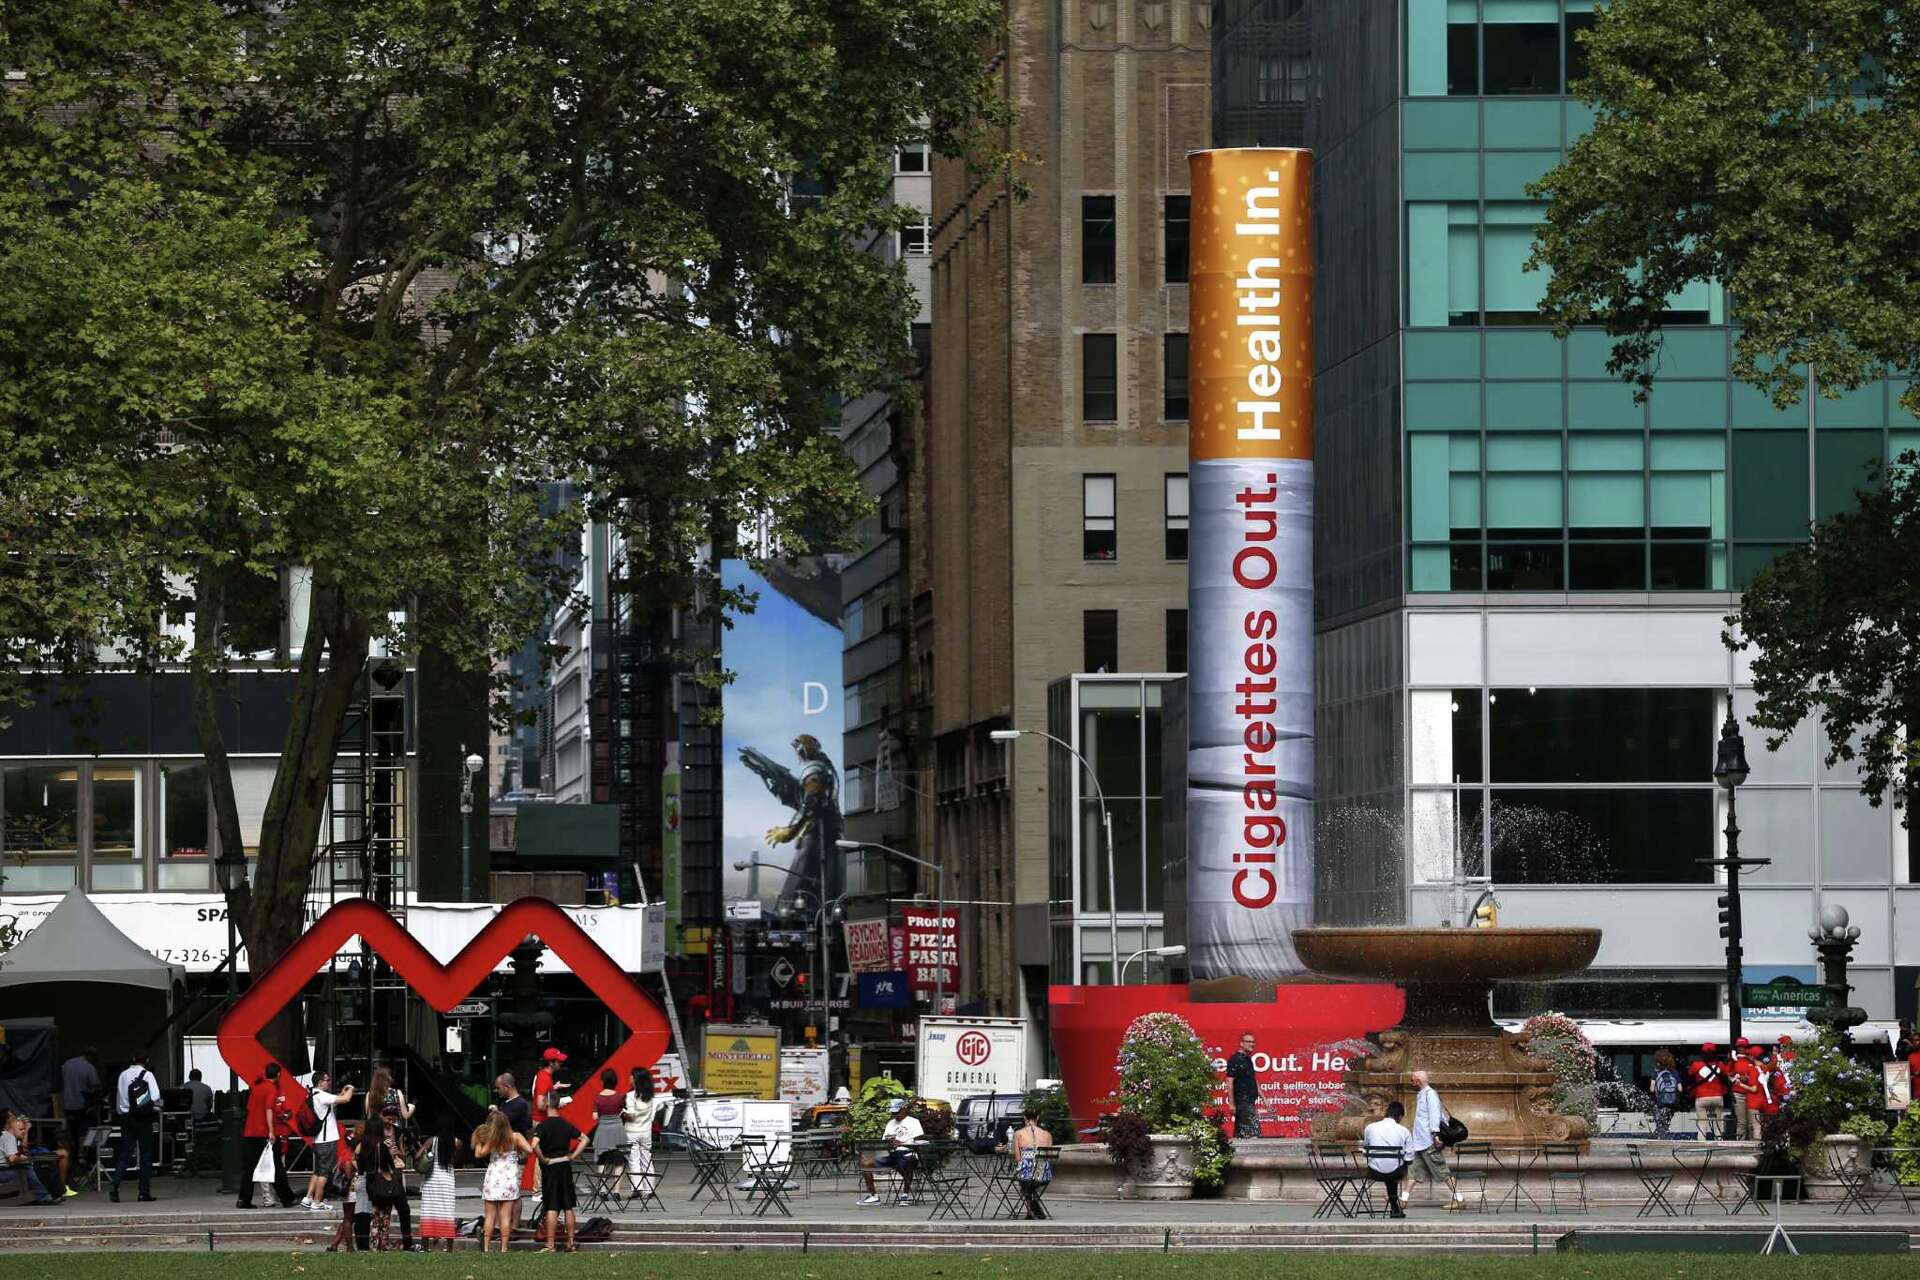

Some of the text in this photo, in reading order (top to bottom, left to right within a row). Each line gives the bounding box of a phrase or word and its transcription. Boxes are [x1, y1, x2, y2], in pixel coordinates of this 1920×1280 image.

[1235, 170, 1281, 440] Health In.
[1232, 472, 1286, 910] Cigarettes Out.
[907, 916, 956, 928] PRONTO
[848, 921, 884, 944] PSYCHIC
[909, 933, 957, 948] PIZZA
[909, 950, 958, 966] PASTA
[917, 967, 952, 983] BAR
[1771, 989, 1821, 1001] Americas
[1748, 1006, 1807, 1015] AVAILABLE
[707, 1051, 773, 1062] MONTEBELLO
[1252, 1052, 1303, 1073] Out.
[947, 1071, 997, 1084] GENERAL
[1260, 1081, 1280, 1091] quit
[1283, 1081, 1316, 1091] selling
[1318, 1081, 1346, 1090] tobac
